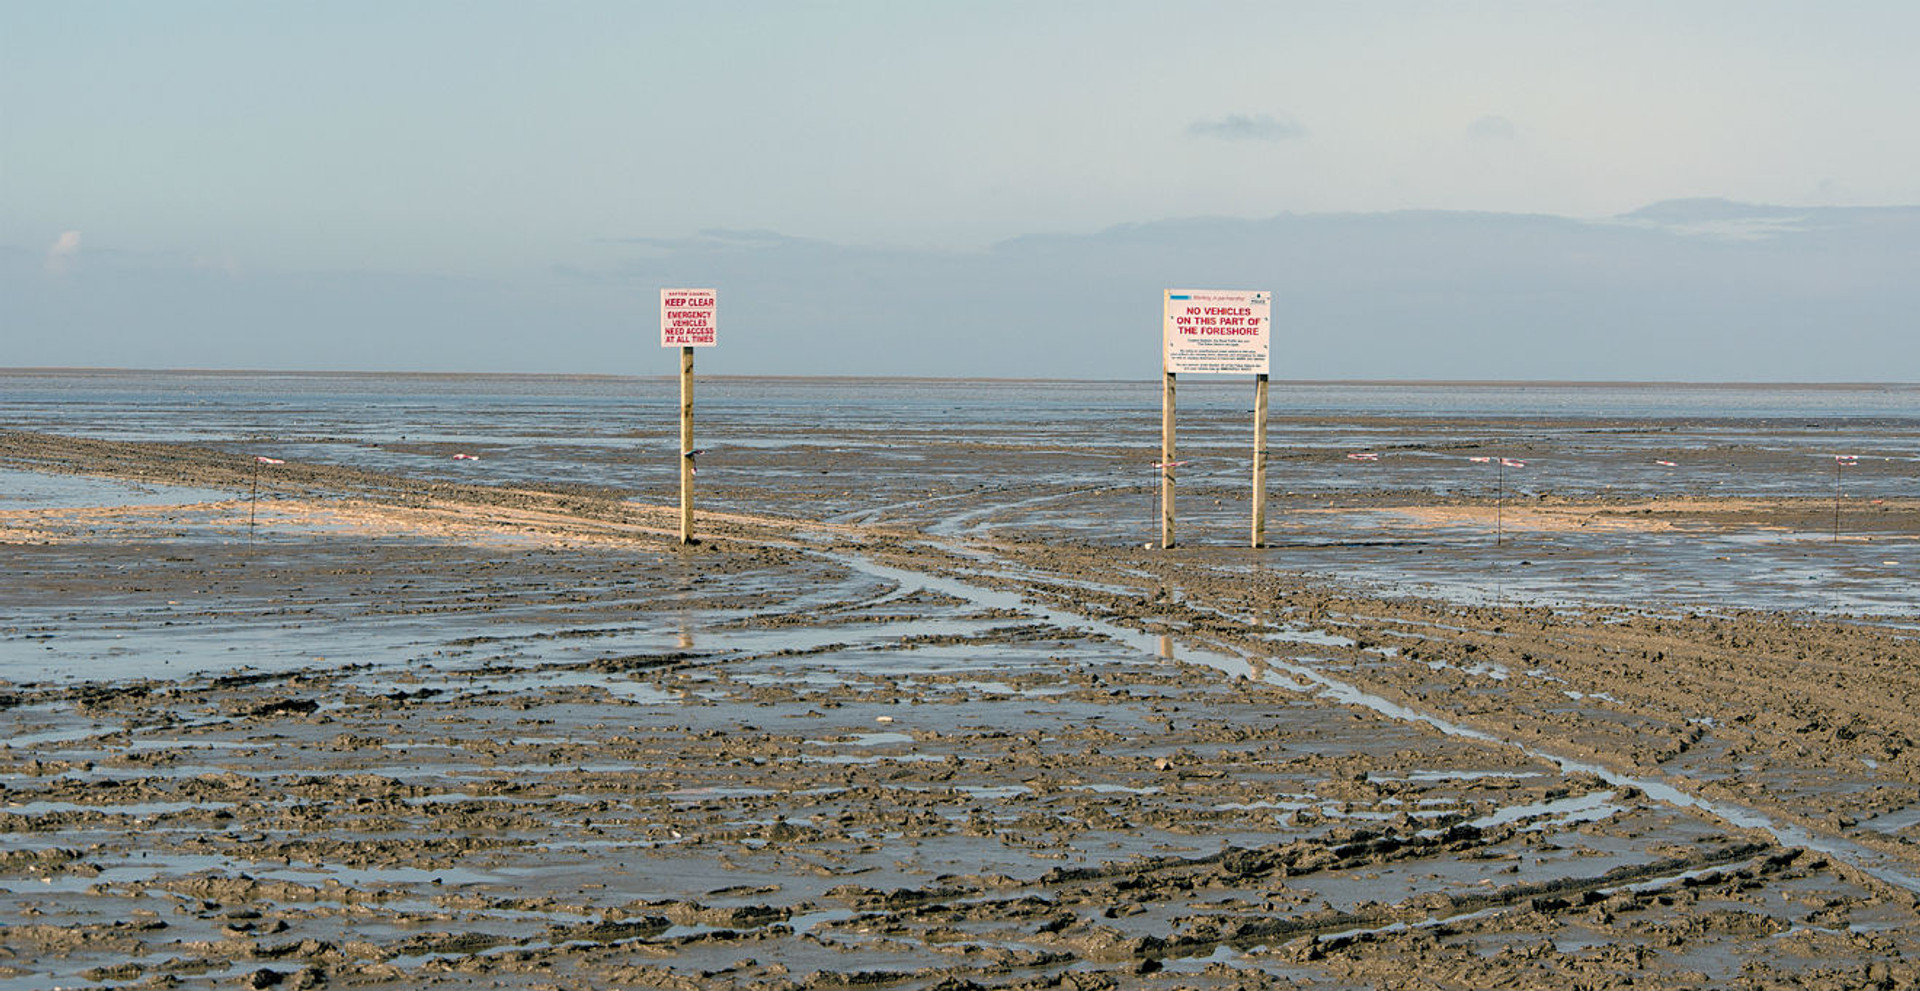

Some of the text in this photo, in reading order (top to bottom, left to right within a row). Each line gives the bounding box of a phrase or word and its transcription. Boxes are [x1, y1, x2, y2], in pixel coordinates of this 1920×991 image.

[665, 298, 714, 306] KEEP CLEAR
[1186, 307, 1251, 316] NO VEHICLES
[1201, 327, 1259, 335] FORESHORE
